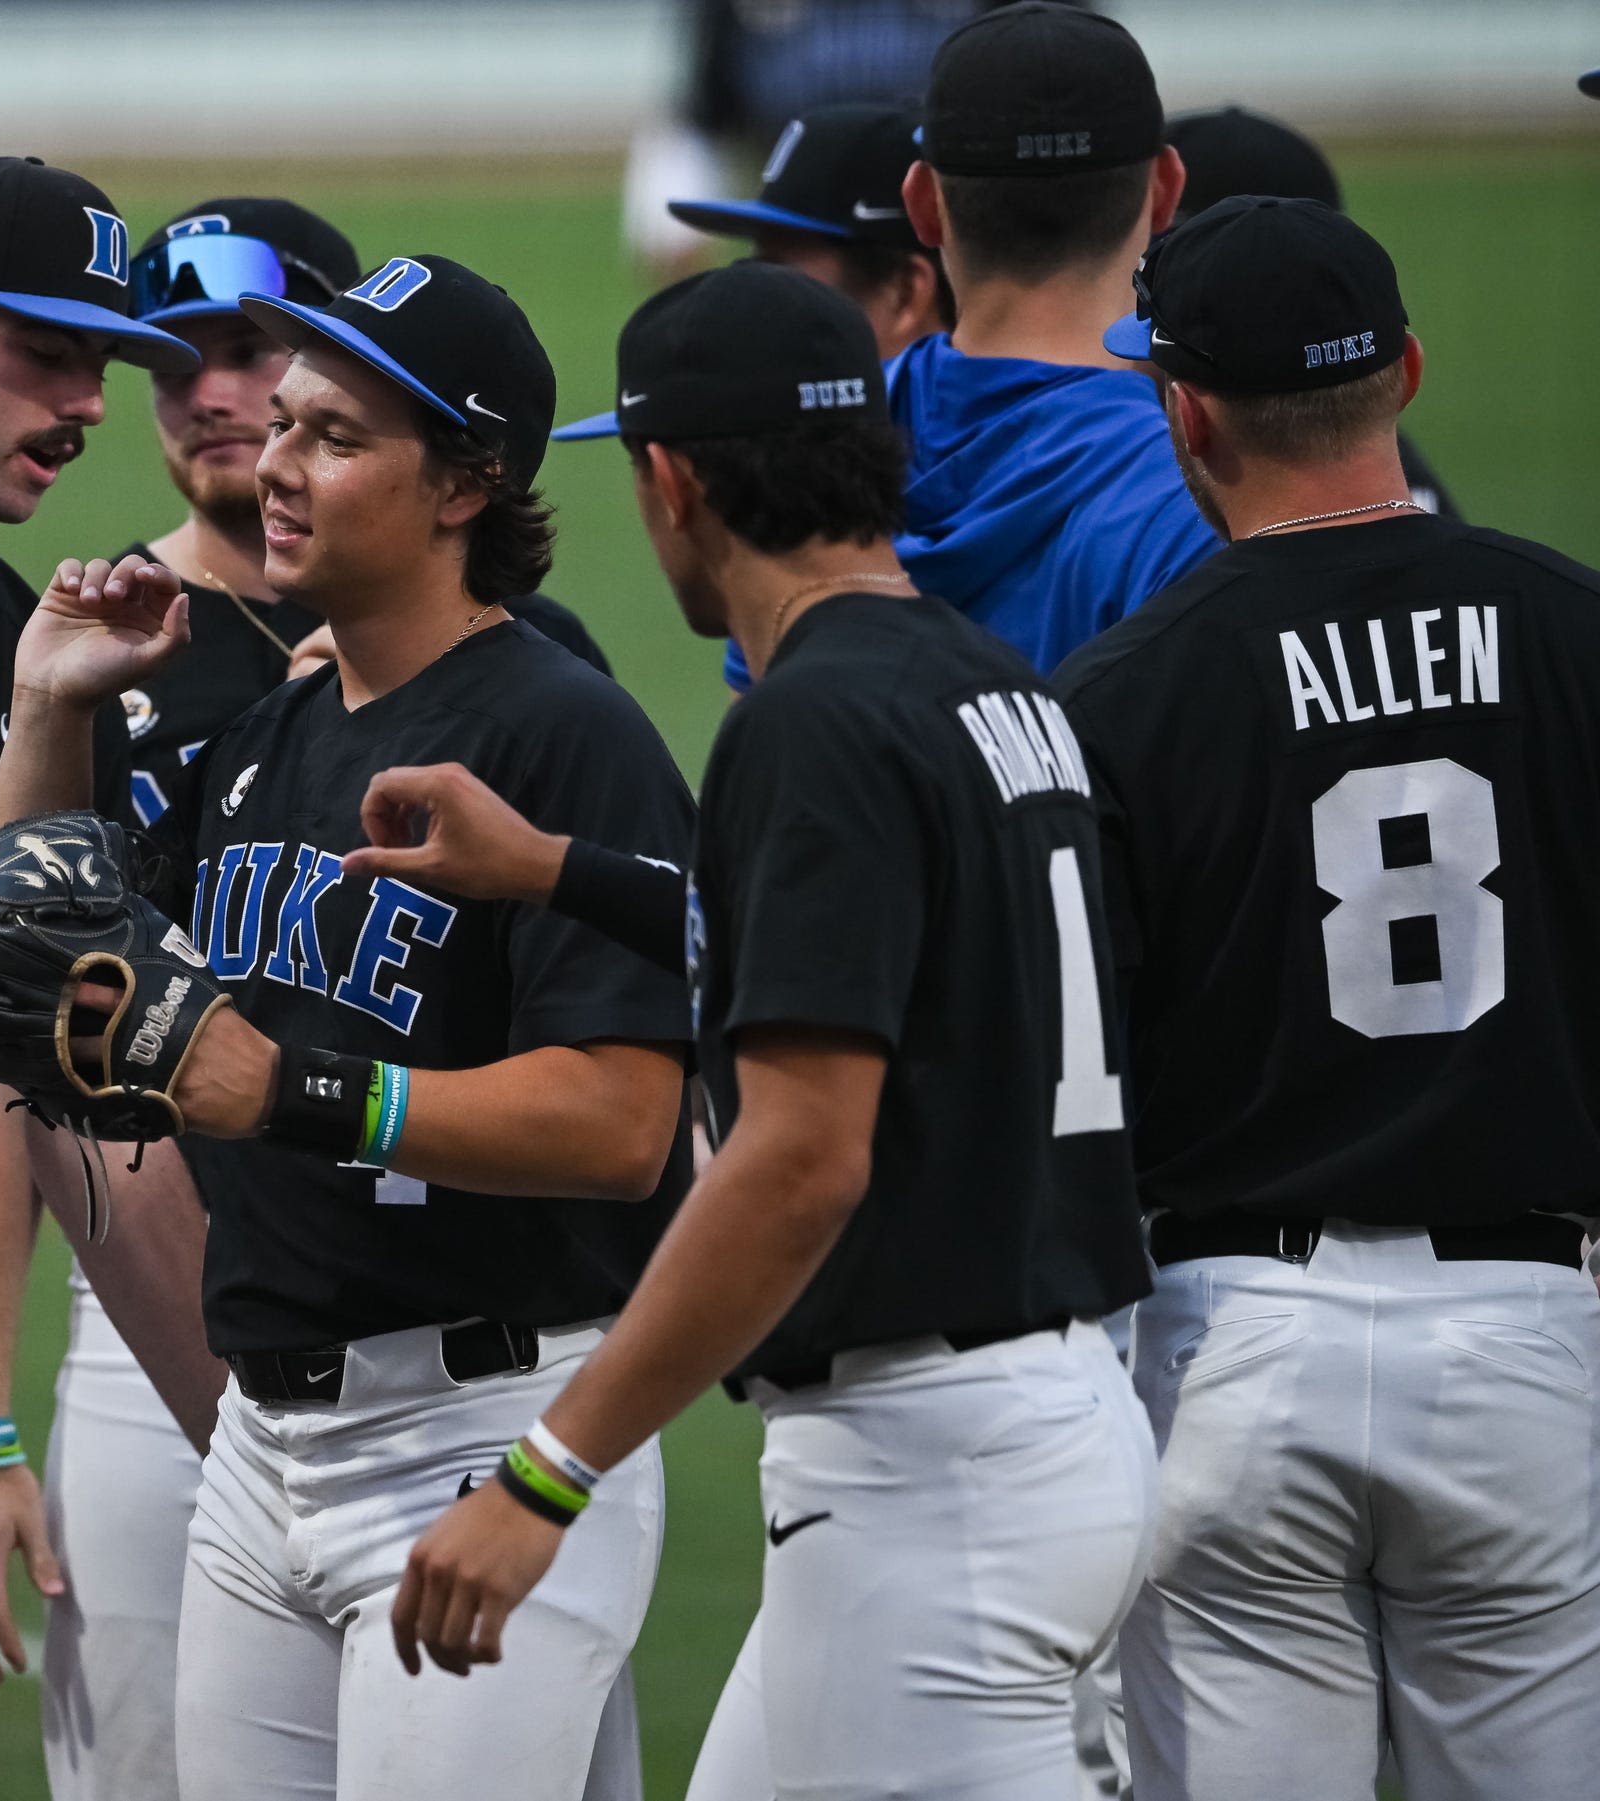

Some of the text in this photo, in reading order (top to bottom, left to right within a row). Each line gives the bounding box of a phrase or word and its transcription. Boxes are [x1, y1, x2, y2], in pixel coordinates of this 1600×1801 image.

[1017, 132, 1090, 158] DUKE
[1304, 331, 1375, 368] DUKE
[798, 378, 866, 408] DUKE
[1279, 605, 1500, 730] ALLEN
[1312, 757, 1506, 1039] 8
[125, 975, 192, 1065] Wilson
[1049, 846, 1125, 1138] 1
[381, 1069, 401, 1151] CHAMPIONSHIP
